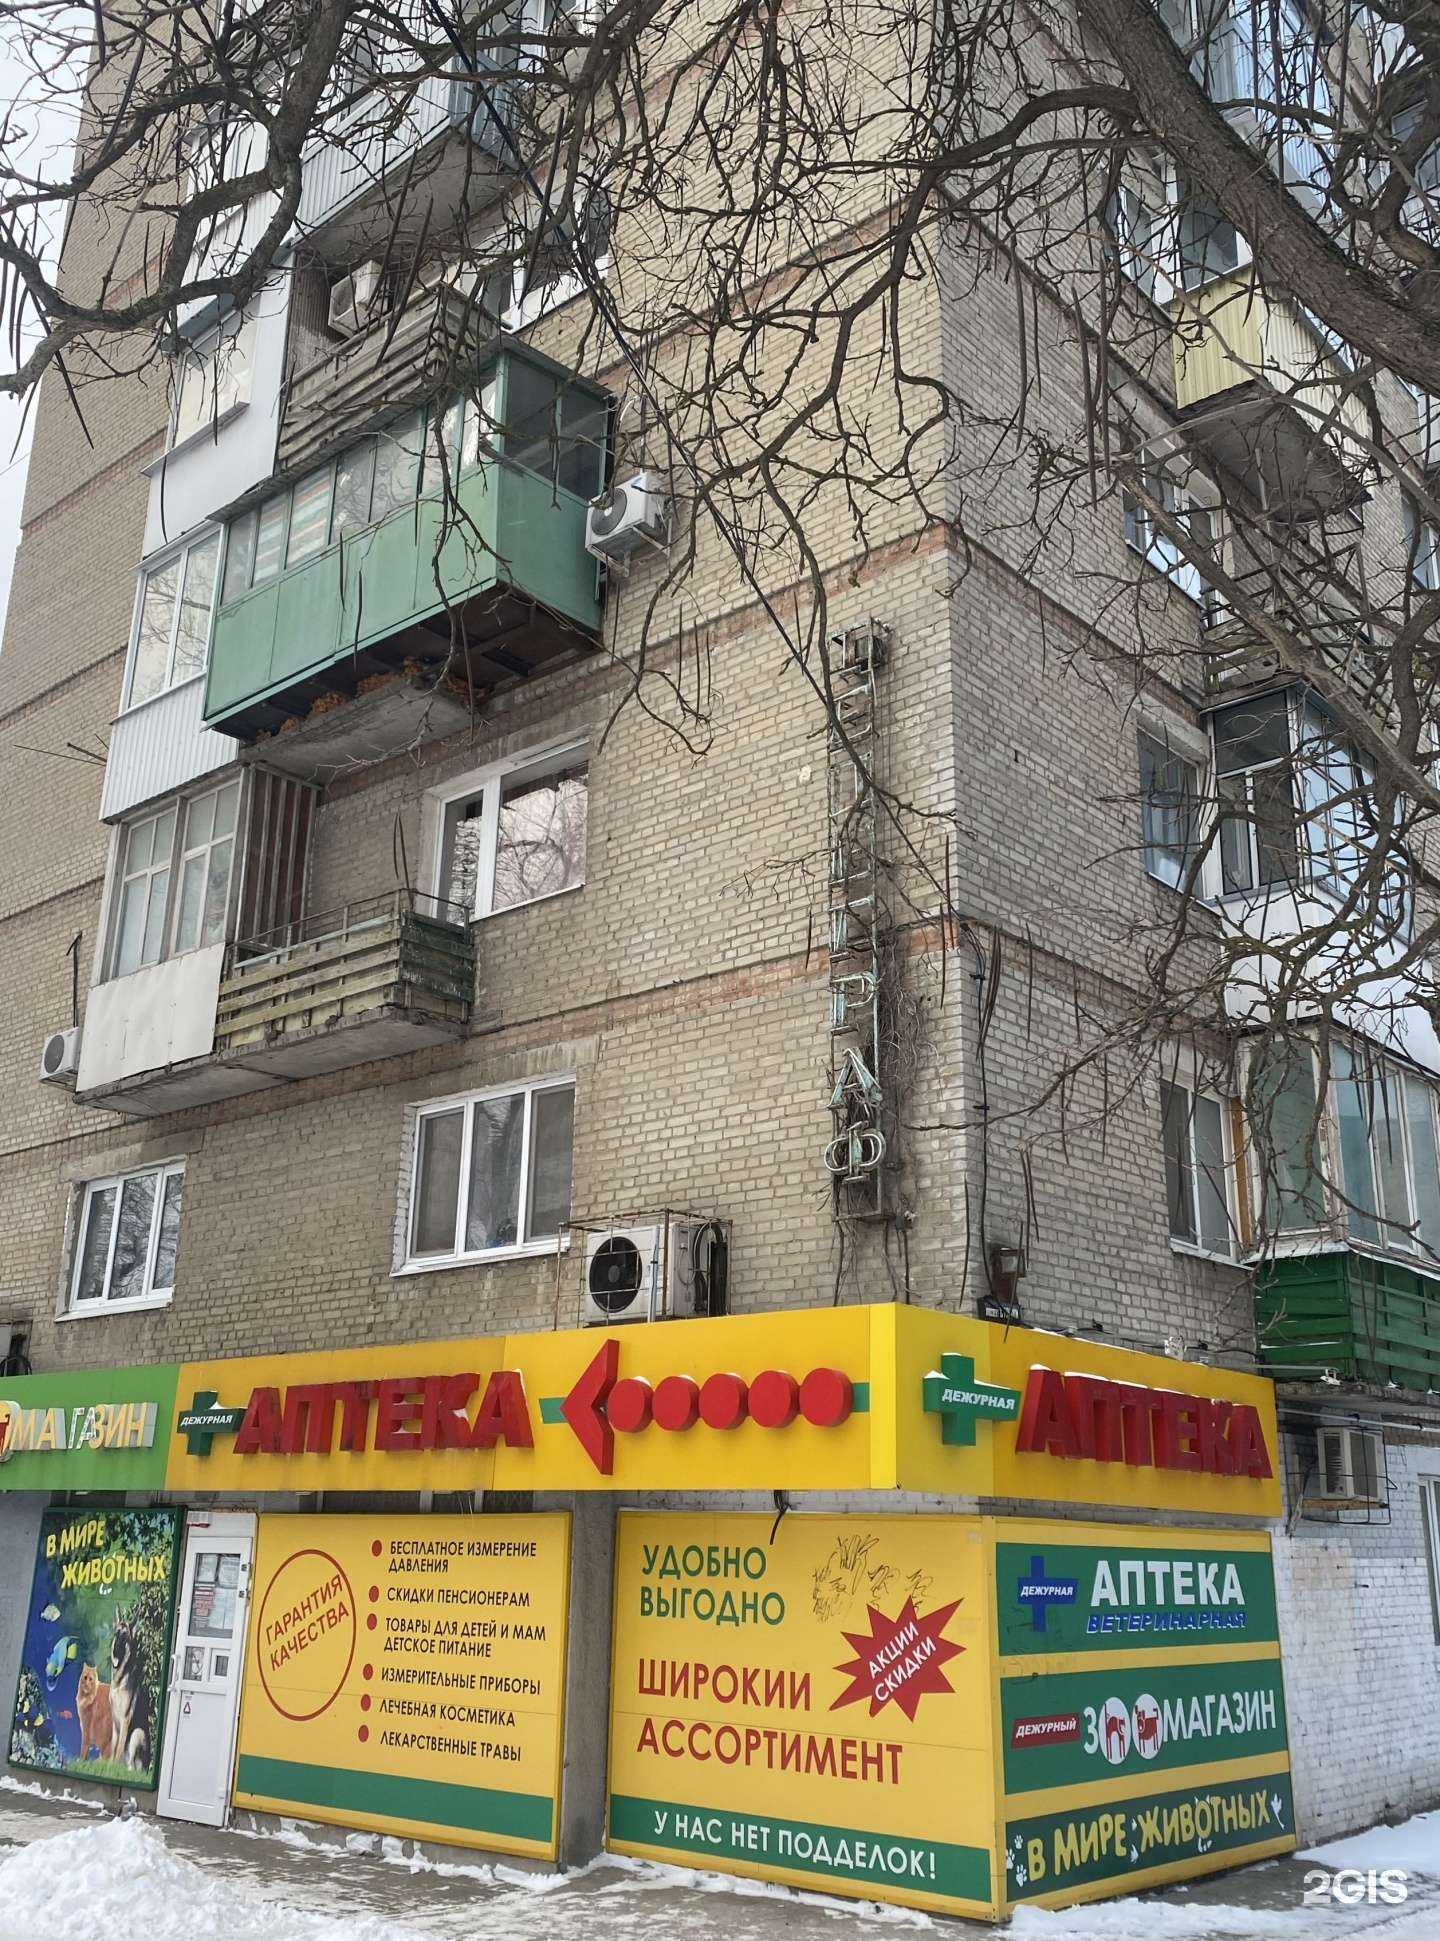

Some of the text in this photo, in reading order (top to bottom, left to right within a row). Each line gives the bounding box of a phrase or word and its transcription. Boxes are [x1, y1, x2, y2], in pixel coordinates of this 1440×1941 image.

[233, 1369, 534, 1456] АПТЕКА
[941, 1388, 1015, 1411] ДЕЖУРНАЯ
[181, 1413, 233, 1426] ДЕЖУРНАЯ
[1015, 1366, 1273, 1479] АПТЕКА
[46, 1520, 106, 1559] В МИРЕ
[390, 1541, 537, 1557] БЕСПЛАТНОЕ ИЗМЕРЕНИЕ
[61, 1553, 167, 1590] ЖИВОТНЫХ
[388, 1558, 449, 1574] ДАВЛЕНИЯ
[641, 1544, 767, 1580] УДОБНО
[387, 1587, 530, 1607] СКИДКИ ПЕНСИОНЕРАМ
[1020, 1584, 1074, 1598] ДЕЖУРНАЯ
[1090, 1560, 1245, 1607] АПТЕКА
[265, 1574, 344, 1646] ГАРАНТИЯ
[640, 1586, 786, 1627] ВЫГОДНО
[1086, 1612, 1247, 1634] ВЕТЕРИНАРНАЯ
[269, 1601, 350, 1672] КАЧЕСТВА
[385, 1617, 546, 1641] ТОВАРЫ ДЛЯ ДЕТЕЙ И МАМ
[384, 1637, 492, 1658] ДЕТСКОЕ ПИТАНИЕ
[868, 1621, 919, 1679] АКЦИИ
[381, 1667, 541, 1695] ИЗМЕРИТЕЛЬНЫЕ ПРИБОРЫ
[874, 1636, 936, 1701] СКИДКИ
[379, 1699, 516, 1727] ЛЕЧЕБНАЯ КОСМЕТИКА
[1015, 1717, 1078, 1738] ДЕЖУРНЫЙ
[380, 1731, 521, 1762] ЛЕКАРСТВЕННЫЕ ТРАВЫ
[636, 1717, 903, 1785] АССОРТИМЕНТ
[653, 1810, 936, 1880] У НАС НЕТ ПОДДЕЛОК!
[1027, 1790, 1270, 1882] В МИРЕ ЖИВОТНЫХ
